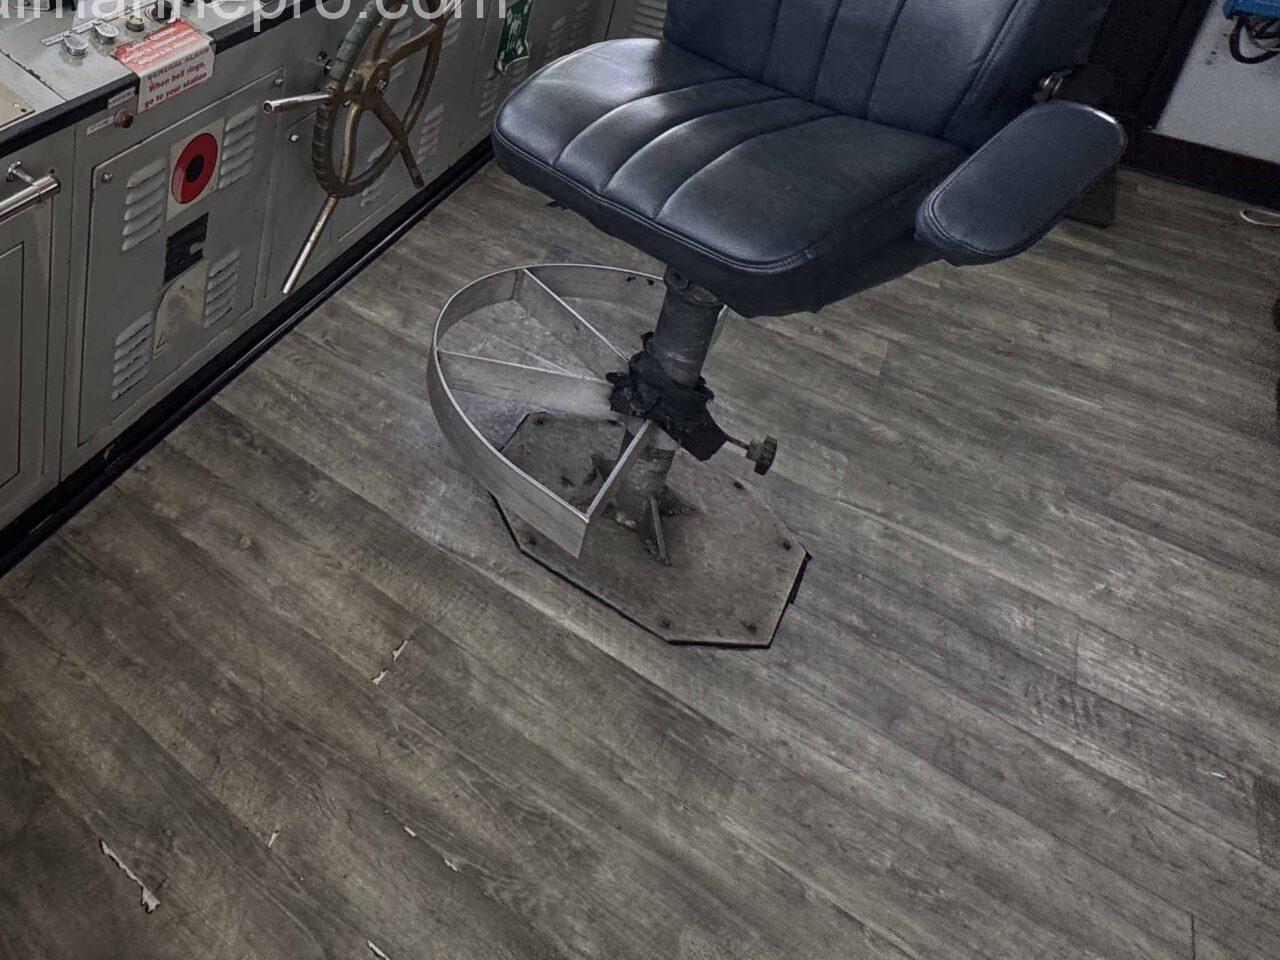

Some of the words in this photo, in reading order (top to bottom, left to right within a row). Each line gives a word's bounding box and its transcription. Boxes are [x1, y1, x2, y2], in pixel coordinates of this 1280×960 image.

[144, 99, 155, 111] go
[156, 93, 164, 103] to
[166, 86, 181, 99] your
[183, 73, 207, 89] station
[149, 78, 170, 93] When
[172, 69, 185, 81] bell
[186, 62, 206, 75] rings,
